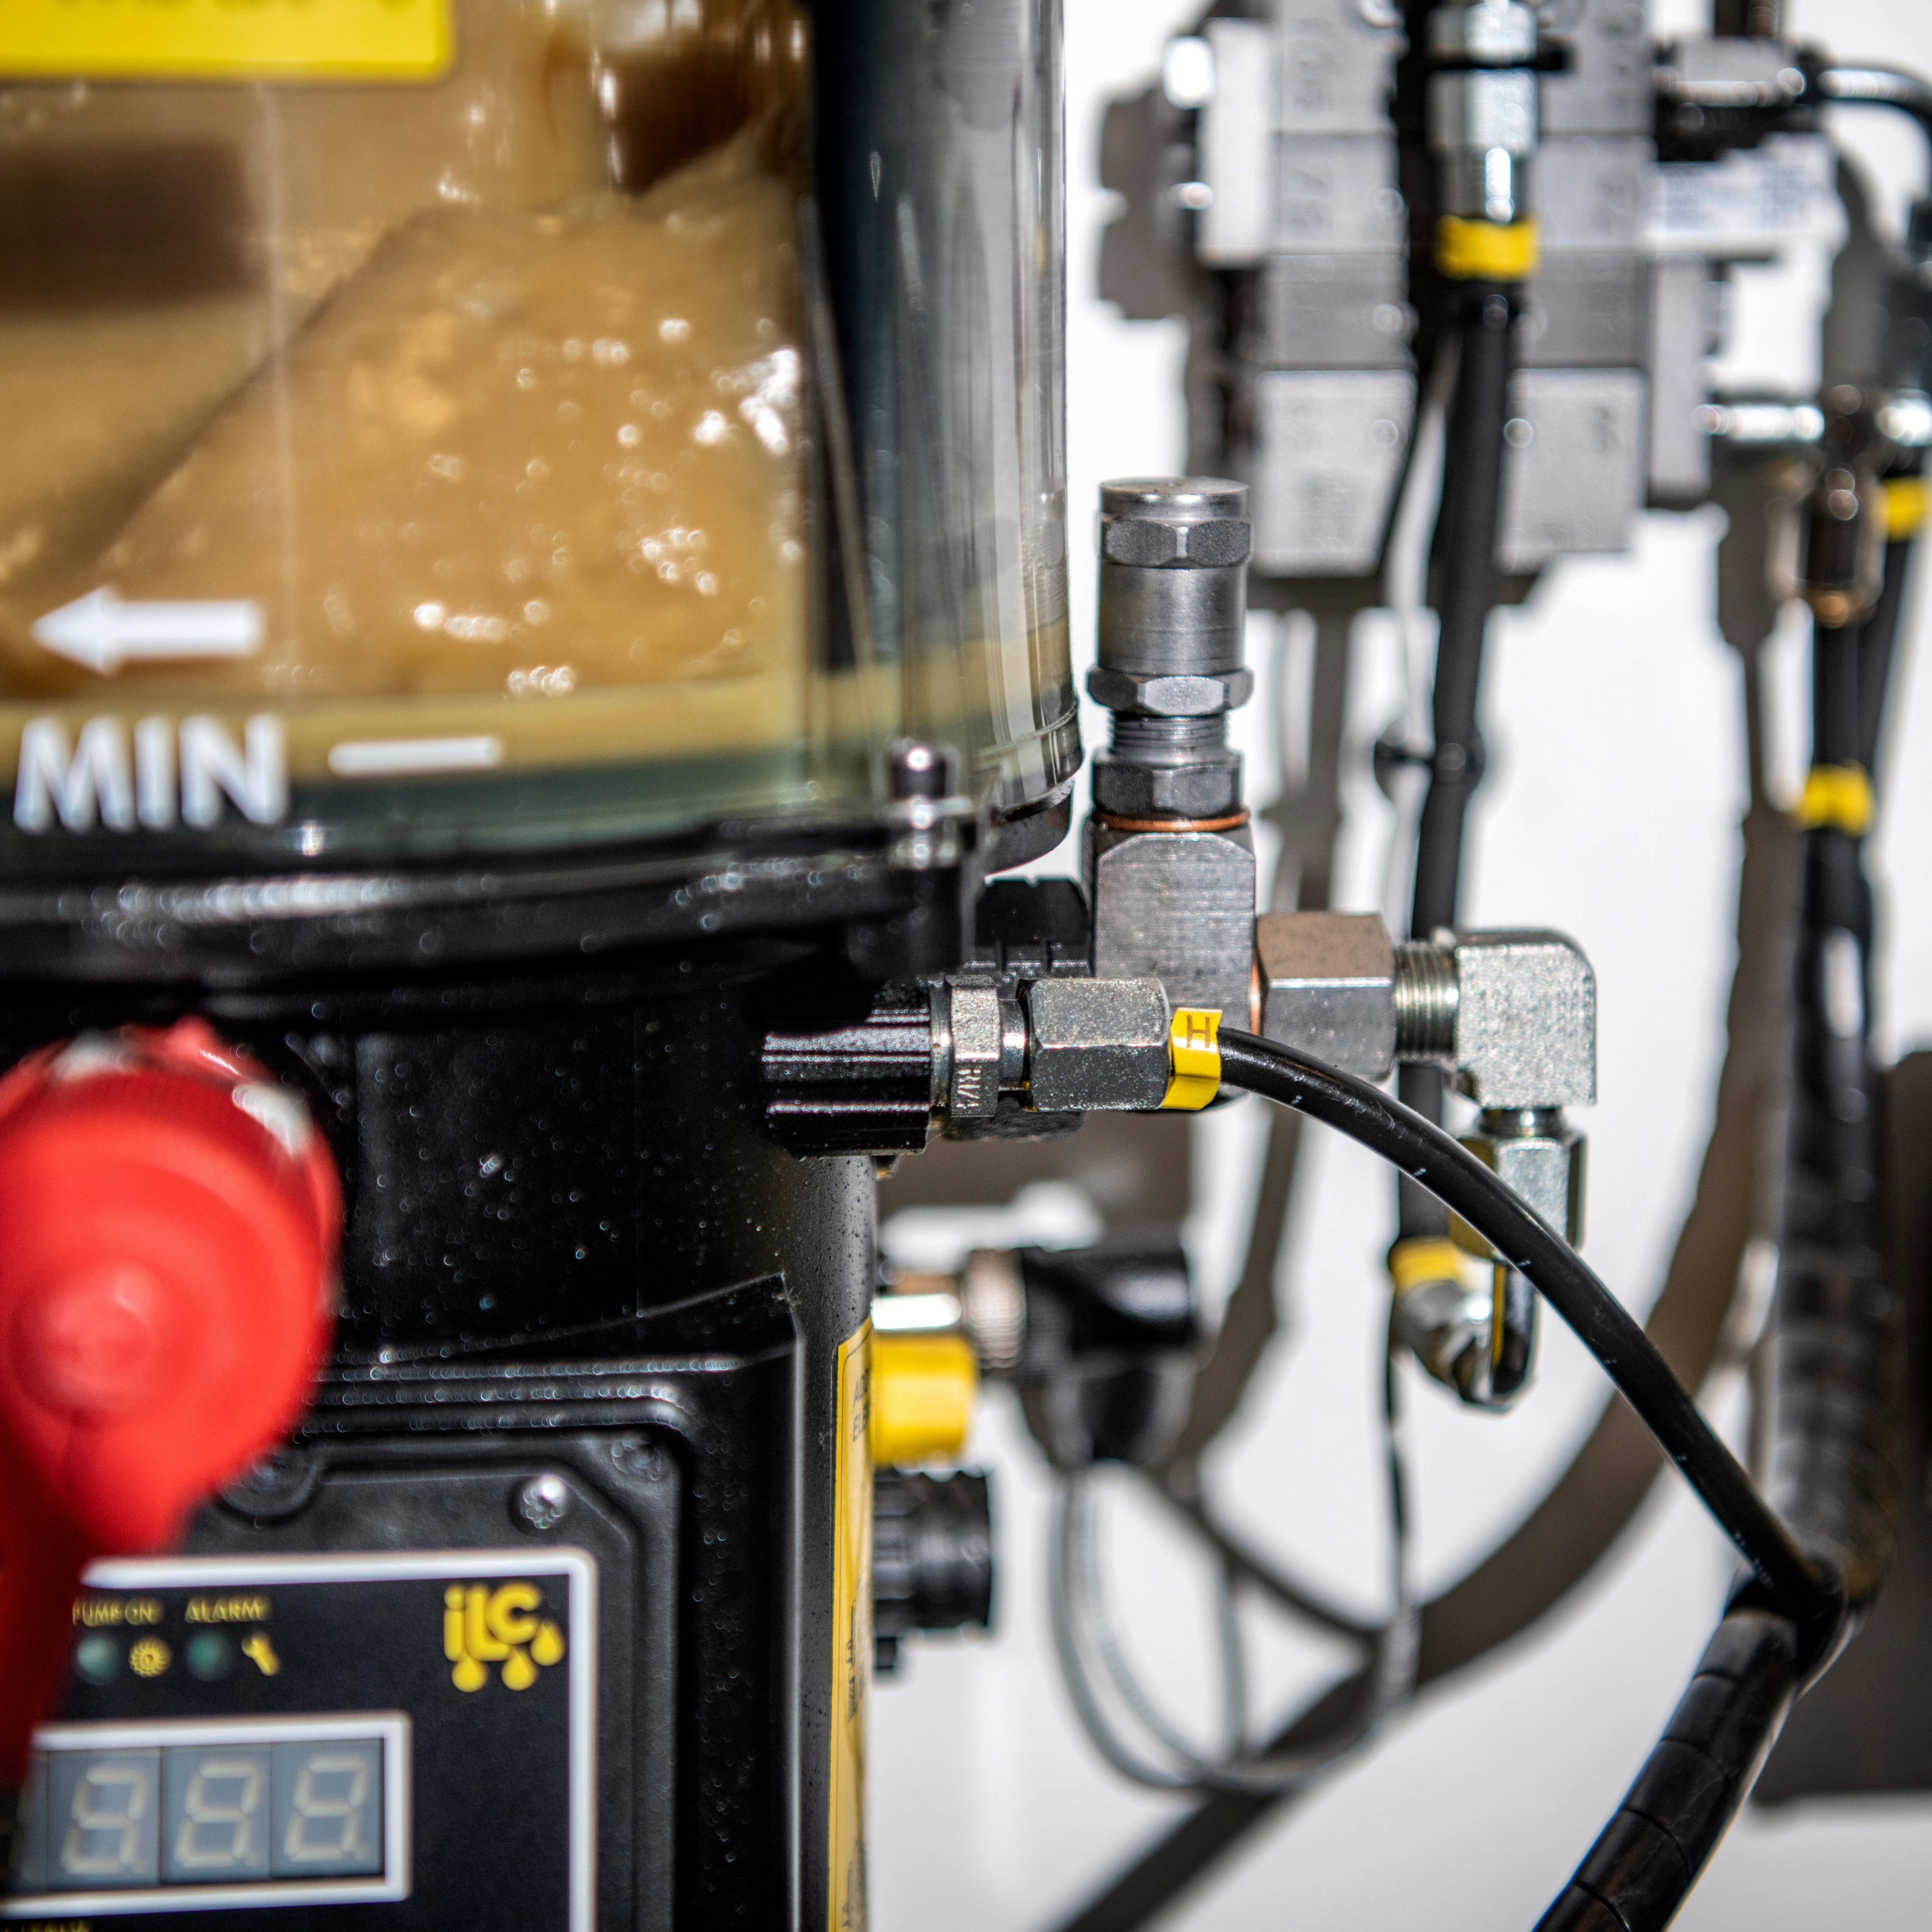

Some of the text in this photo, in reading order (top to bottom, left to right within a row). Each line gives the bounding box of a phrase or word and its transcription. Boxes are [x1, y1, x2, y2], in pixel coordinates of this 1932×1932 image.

[13, 713, 290, 834] MIN
[1186, 1014, 1211, 1049] H
[184, 1595, 271, 1623] ALARM
